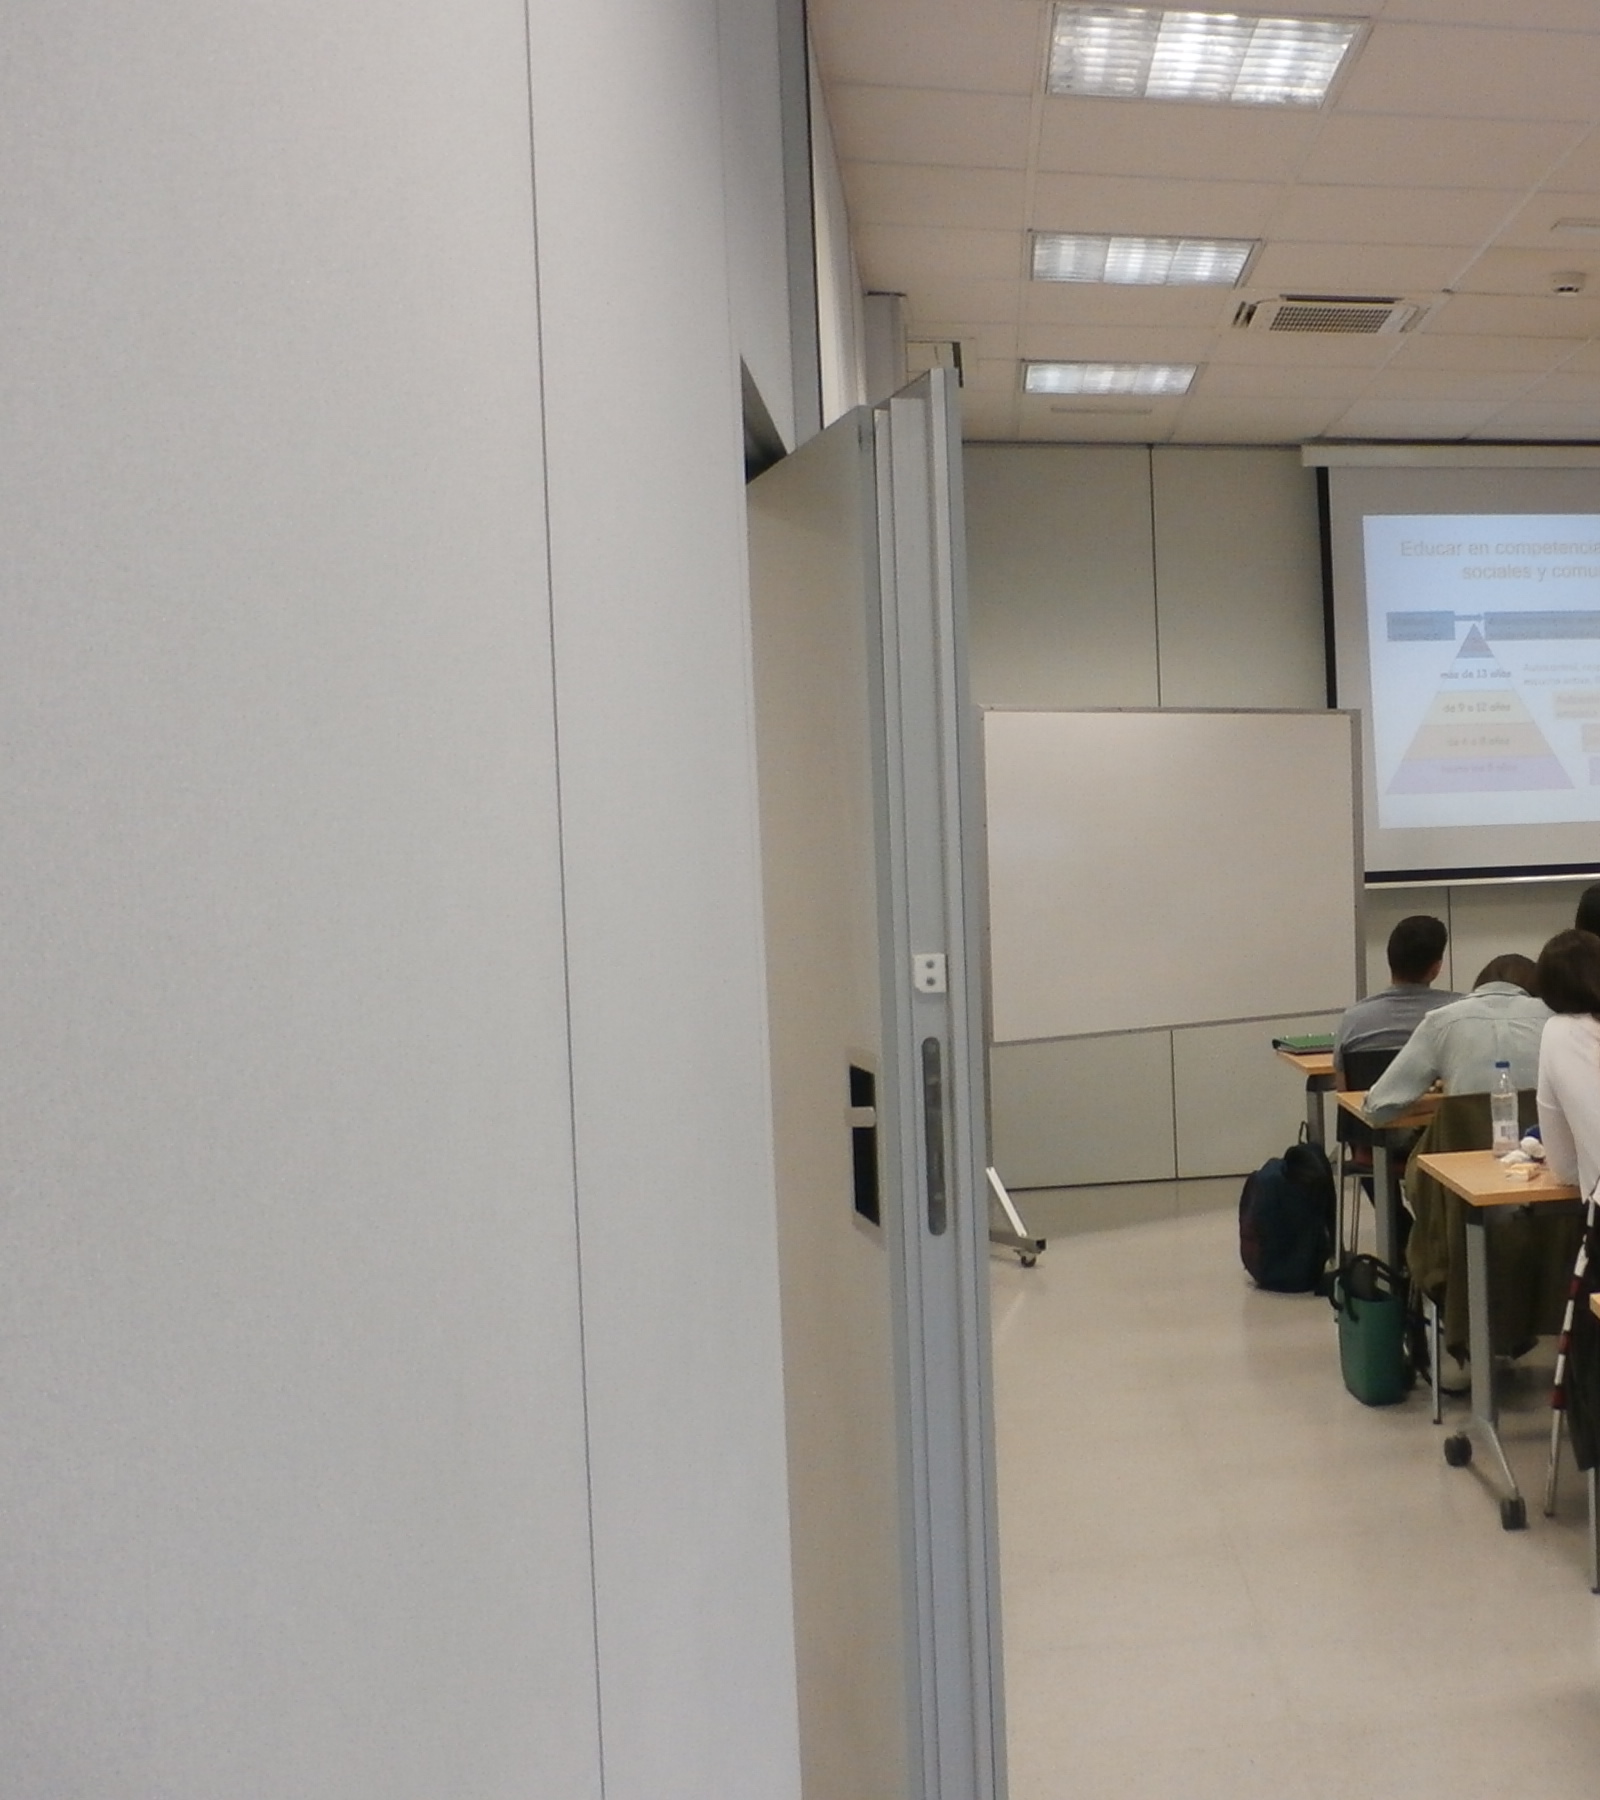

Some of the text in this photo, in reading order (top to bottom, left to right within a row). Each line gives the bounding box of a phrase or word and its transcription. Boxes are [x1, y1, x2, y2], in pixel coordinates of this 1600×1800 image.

[1400, 540, 1462, 557] Educar
[1468, 541, 1489, 556] en
[1462, 563, 1531, 580] sociales
[1538, 567, 1546, 583] y
